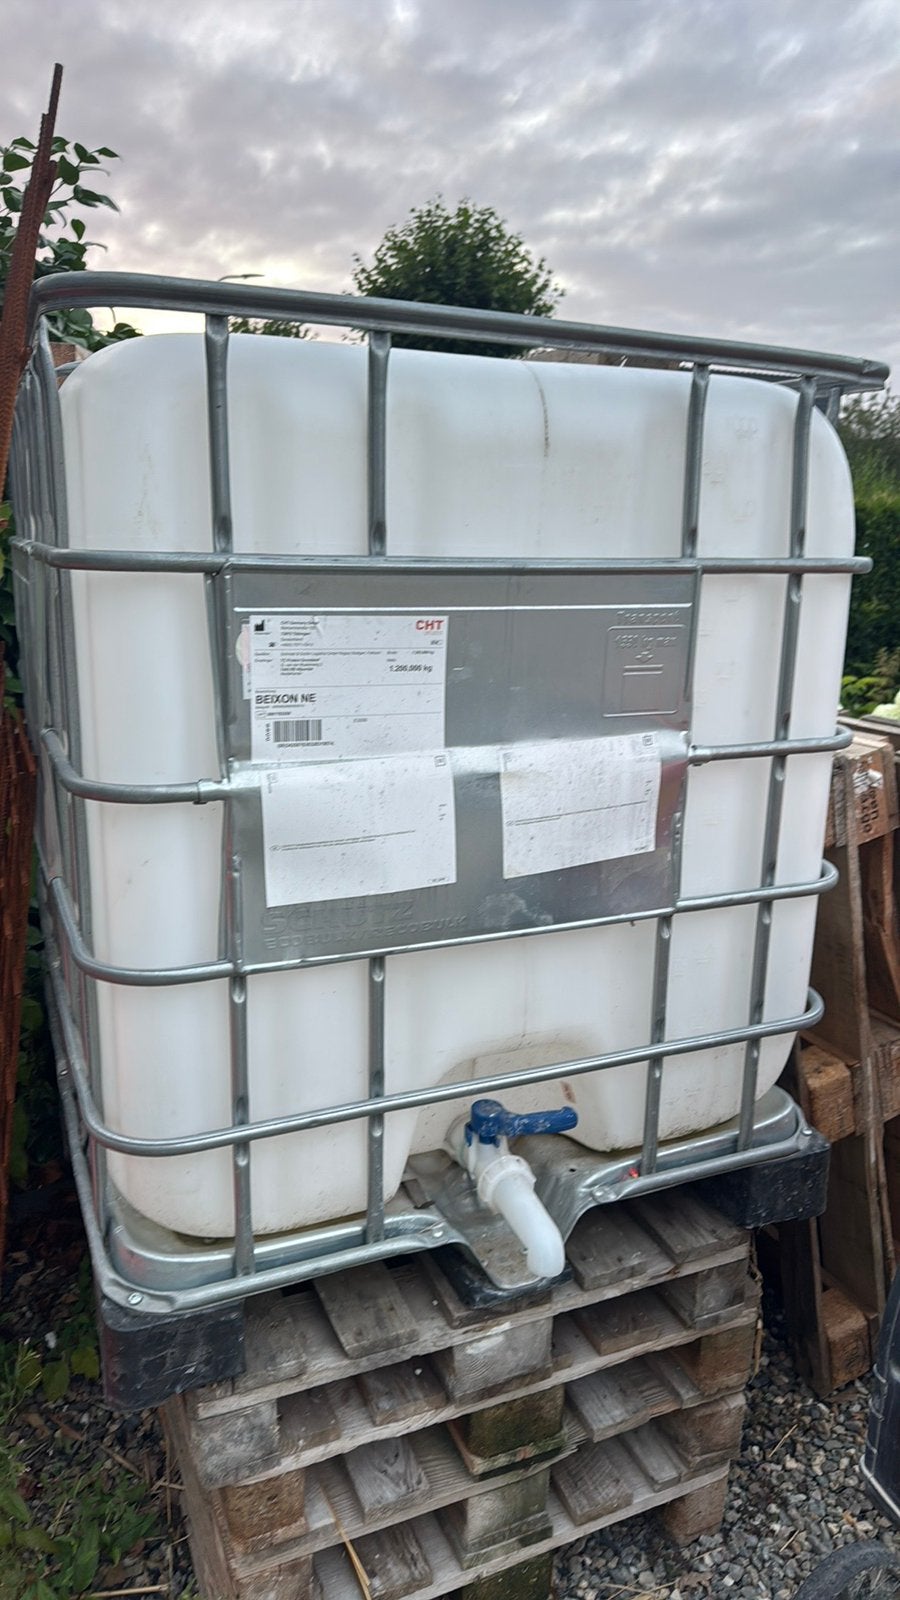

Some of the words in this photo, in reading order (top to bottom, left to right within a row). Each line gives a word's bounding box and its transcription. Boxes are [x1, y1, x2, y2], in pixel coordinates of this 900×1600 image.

[415, 619, 444, 631] CHT
[423, 664, 433, 673] kg
[255, 693, 298, 705] BEIXON
[301, 692, 317, 703] NE
